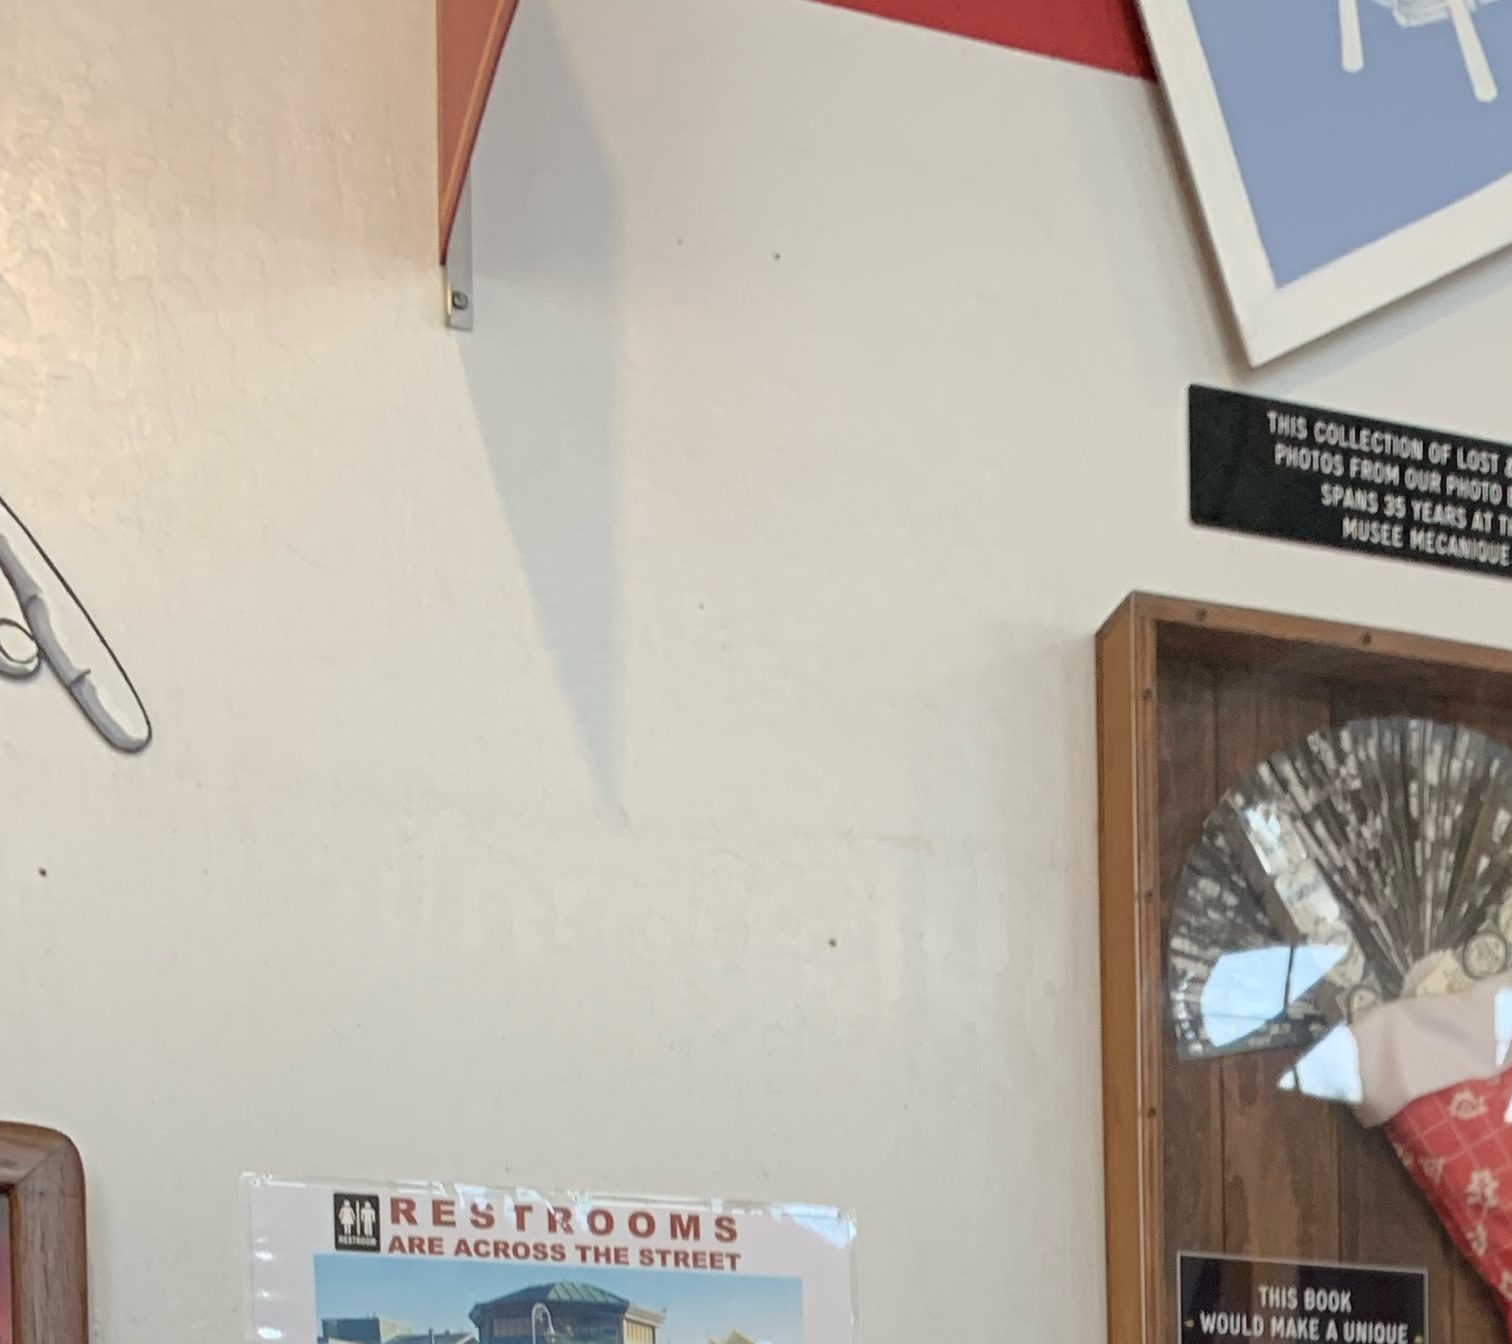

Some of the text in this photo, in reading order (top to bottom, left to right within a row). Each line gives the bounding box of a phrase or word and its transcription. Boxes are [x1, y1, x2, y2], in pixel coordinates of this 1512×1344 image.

[1267, 411, 1308, 440] THIS
[1314, 422, 1424, 461] COLLECTION
[1428, 439, 1451, 465] OF
[1456, 446, 1501, 474] LOST
[1274, 444, 1345, 477] PHOTOS
[1350, 457, 1400, 486] FROM
[1405, 467, 1443, 494] OUR
[1446, 475, 1502, 505] PHOTO
[1320, 483, 1379, 513] SPANS
[1384, 493, 1407, 518] 35
[1411, 499, 1467, 529] YEARS
[1471, 511, 1493, 534] AT
[1342, 516, 1403, 547] MUSEE
[390, 1195, 740, 1244] RESTROOMS
[387, 1235, 742, 1273] ARE ACROSS THE STREET
[1259, 1285, 1352, 1314] THIS BOOK
[1200, 1311, 1264, 1337] WOULD
[1270, 1315, 1320, 1342] MAKE
[1325, 1321, 1339, 1342] A
